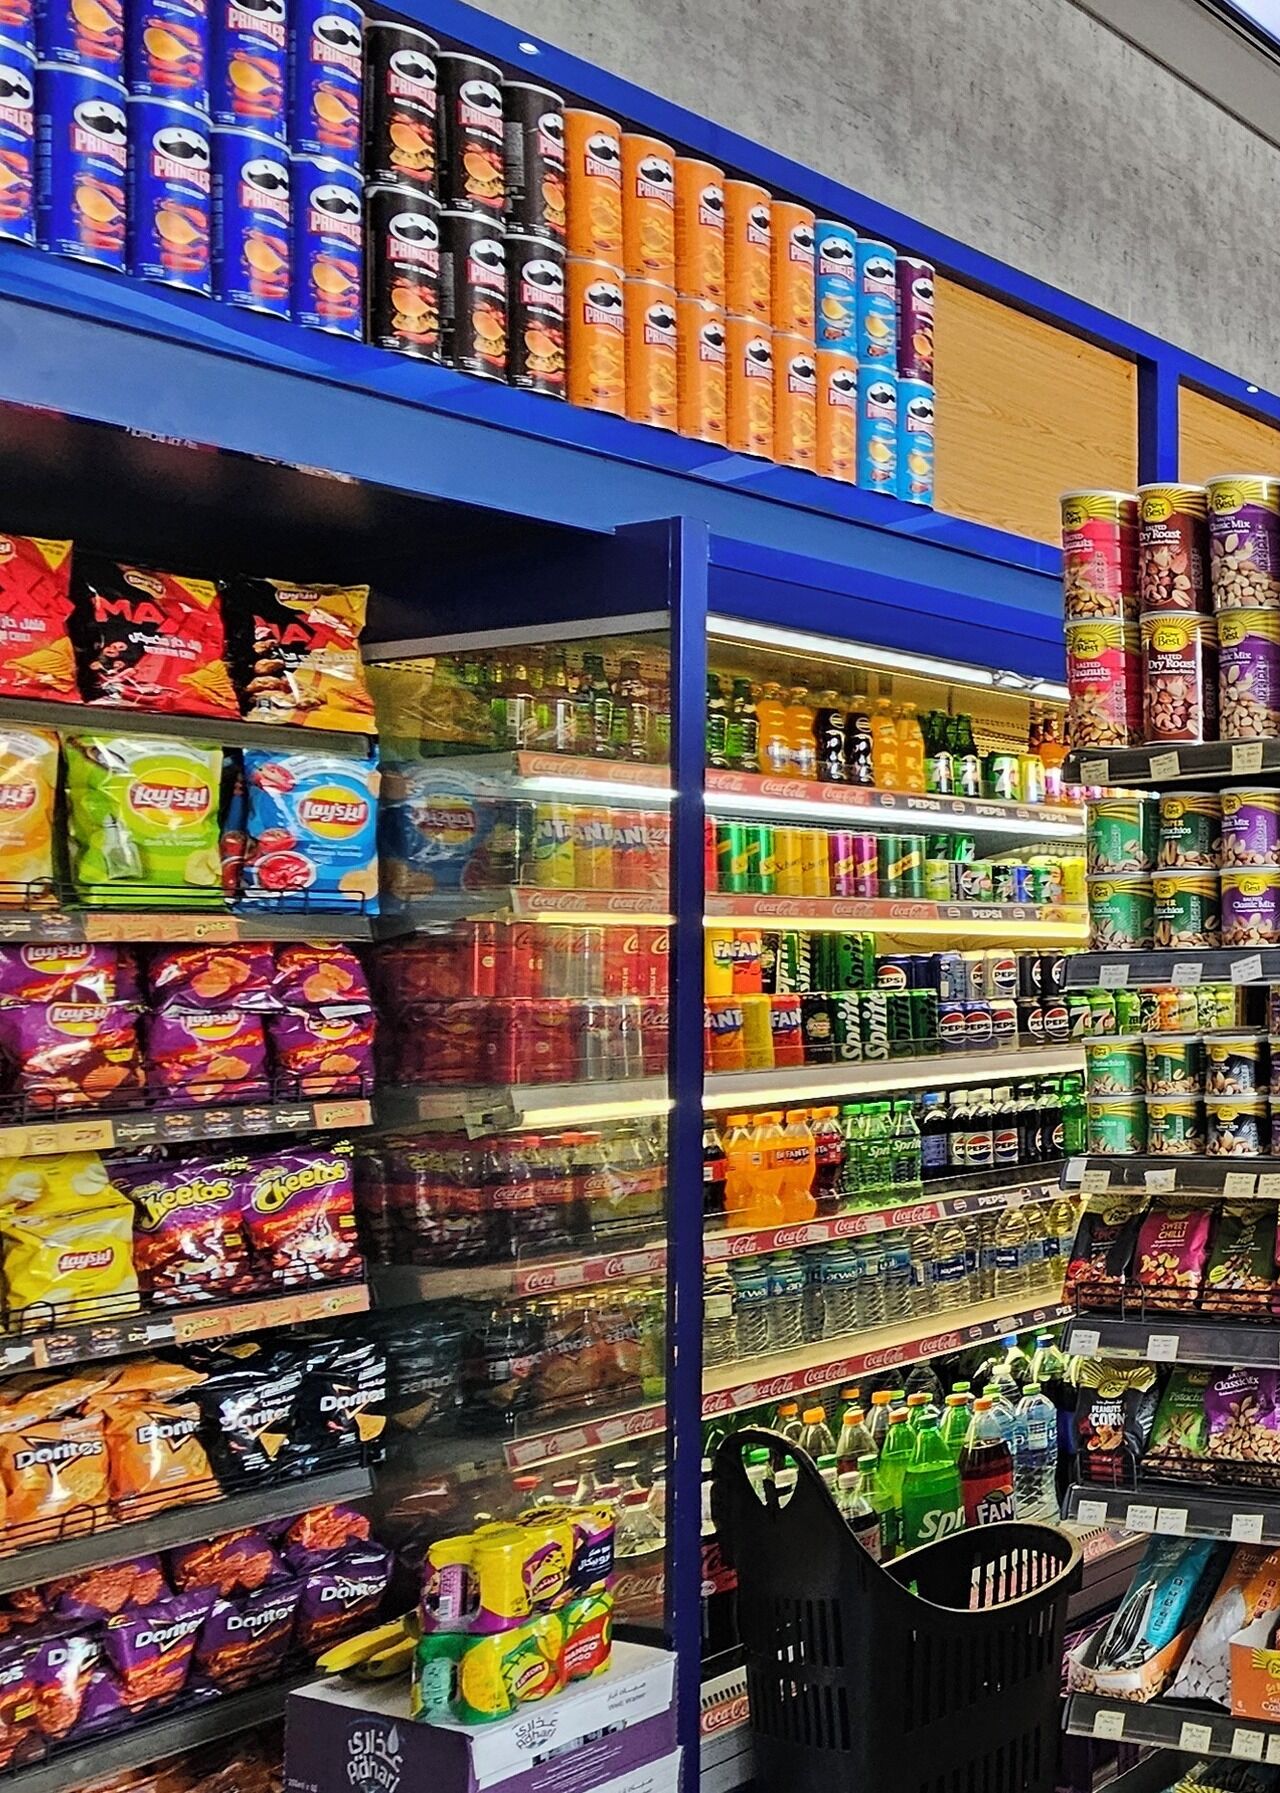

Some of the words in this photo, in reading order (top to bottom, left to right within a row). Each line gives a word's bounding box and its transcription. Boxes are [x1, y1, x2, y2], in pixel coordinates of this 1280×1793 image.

[1215, 499, 1236, 508] Best
[1145, 507, 1165, 516] Best
[1158, 636, 1181, 645] Best
[1166, 660, 1196, 668] Roast
[134, 788, 182, 808] Lay's
[908, 799, 941, 810] PEPSI
[302, 802, 336, 819] Lay's
[976, 806, 1006, 817] PEPSI
[1040, 812, 1067, 821] PEPSI
[972, 908, 1002, 919] PEPSI
[254, 1161, 349, 1213] Cheetos
[16, 1440, 103, 1469] Doritos
[977, 1500, 1018, 1524] FAN
[919, 1508, 965, 1539] Spri
